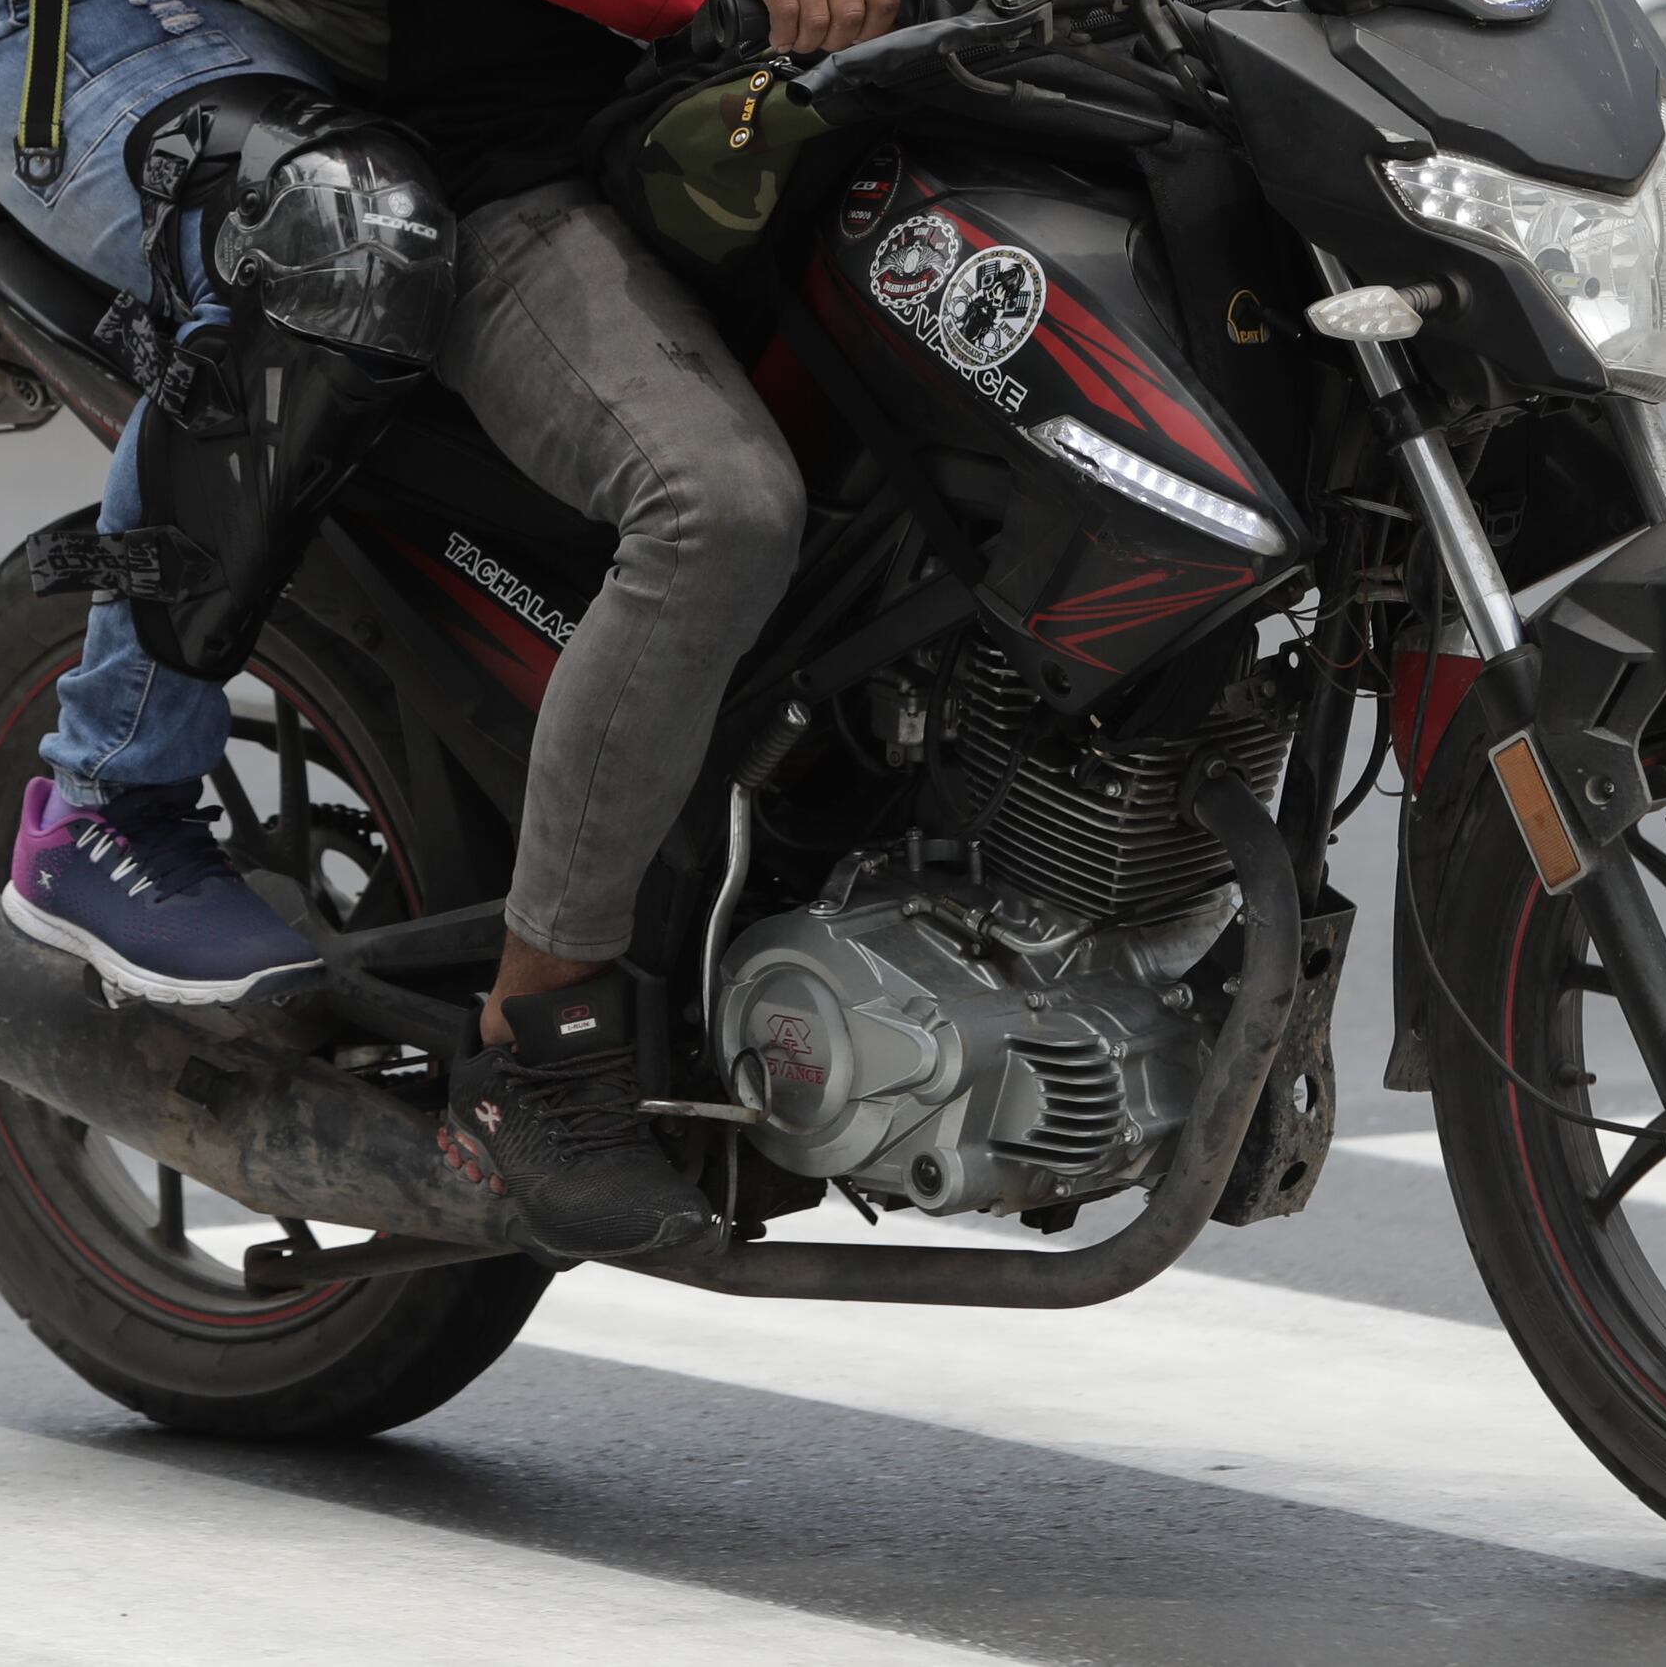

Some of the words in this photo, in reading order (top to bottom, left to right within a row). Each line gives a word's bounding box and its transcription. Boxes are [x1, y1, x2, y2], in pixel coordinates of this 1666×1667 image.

[741, 96, 757, 123] CAT
[362, 212, 438, 240] SCOYCO
[1240, 330, 1259, 343] CAT
[888, 305, 1029, 413] DVCE
[765, 1058, 825, 1085] DVANCE
